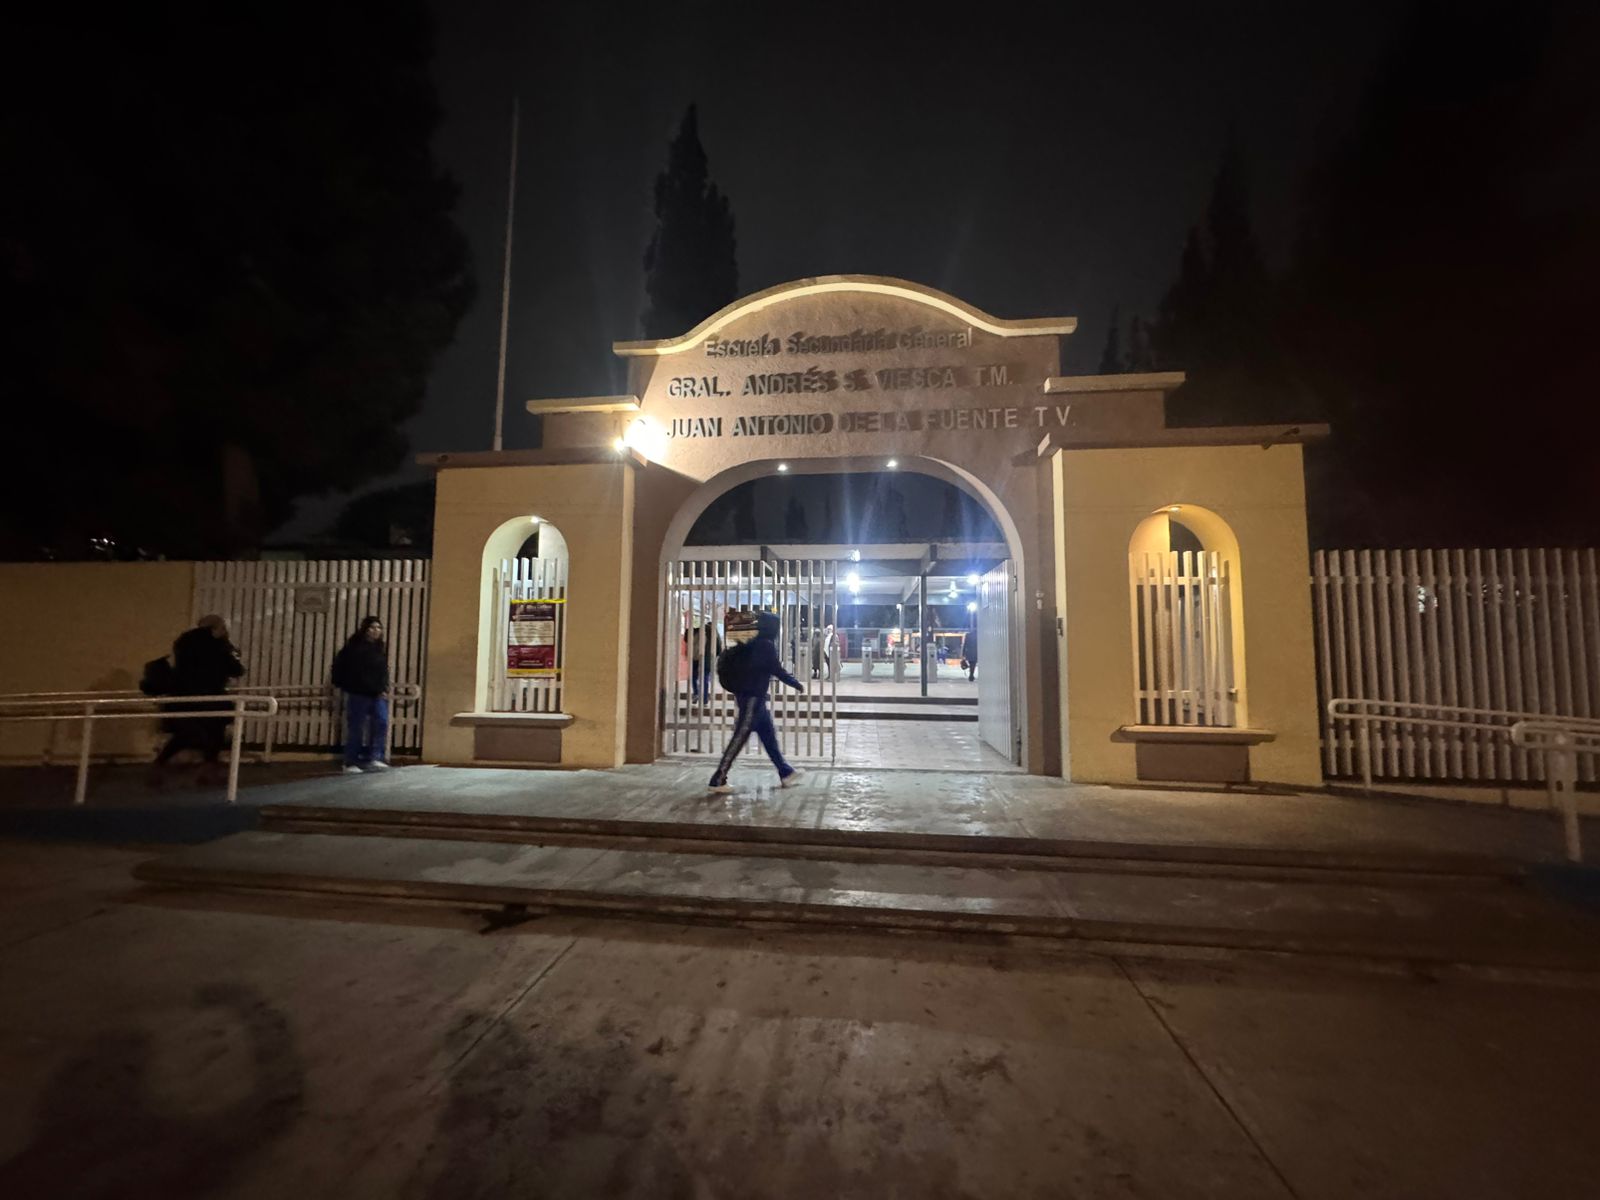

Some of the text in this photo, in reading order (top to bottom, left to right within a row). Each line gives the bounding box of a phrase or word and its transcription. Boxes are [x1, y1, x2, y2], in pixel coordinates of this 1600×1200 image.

[704, 327, 973, 357] Escuela Secundaria General
[669, 377, 731, 398] GRAL.
[743, 366, 830, 396] ANDRÉS
[874, 367, 957, 391] VIESCA
[667, 417, 722, 438] JUAN
[732, 413, 826, 437] ANTONIO
[880, 409, 912, 432] LA
[925, 407, 1018, 431] FUENTE
